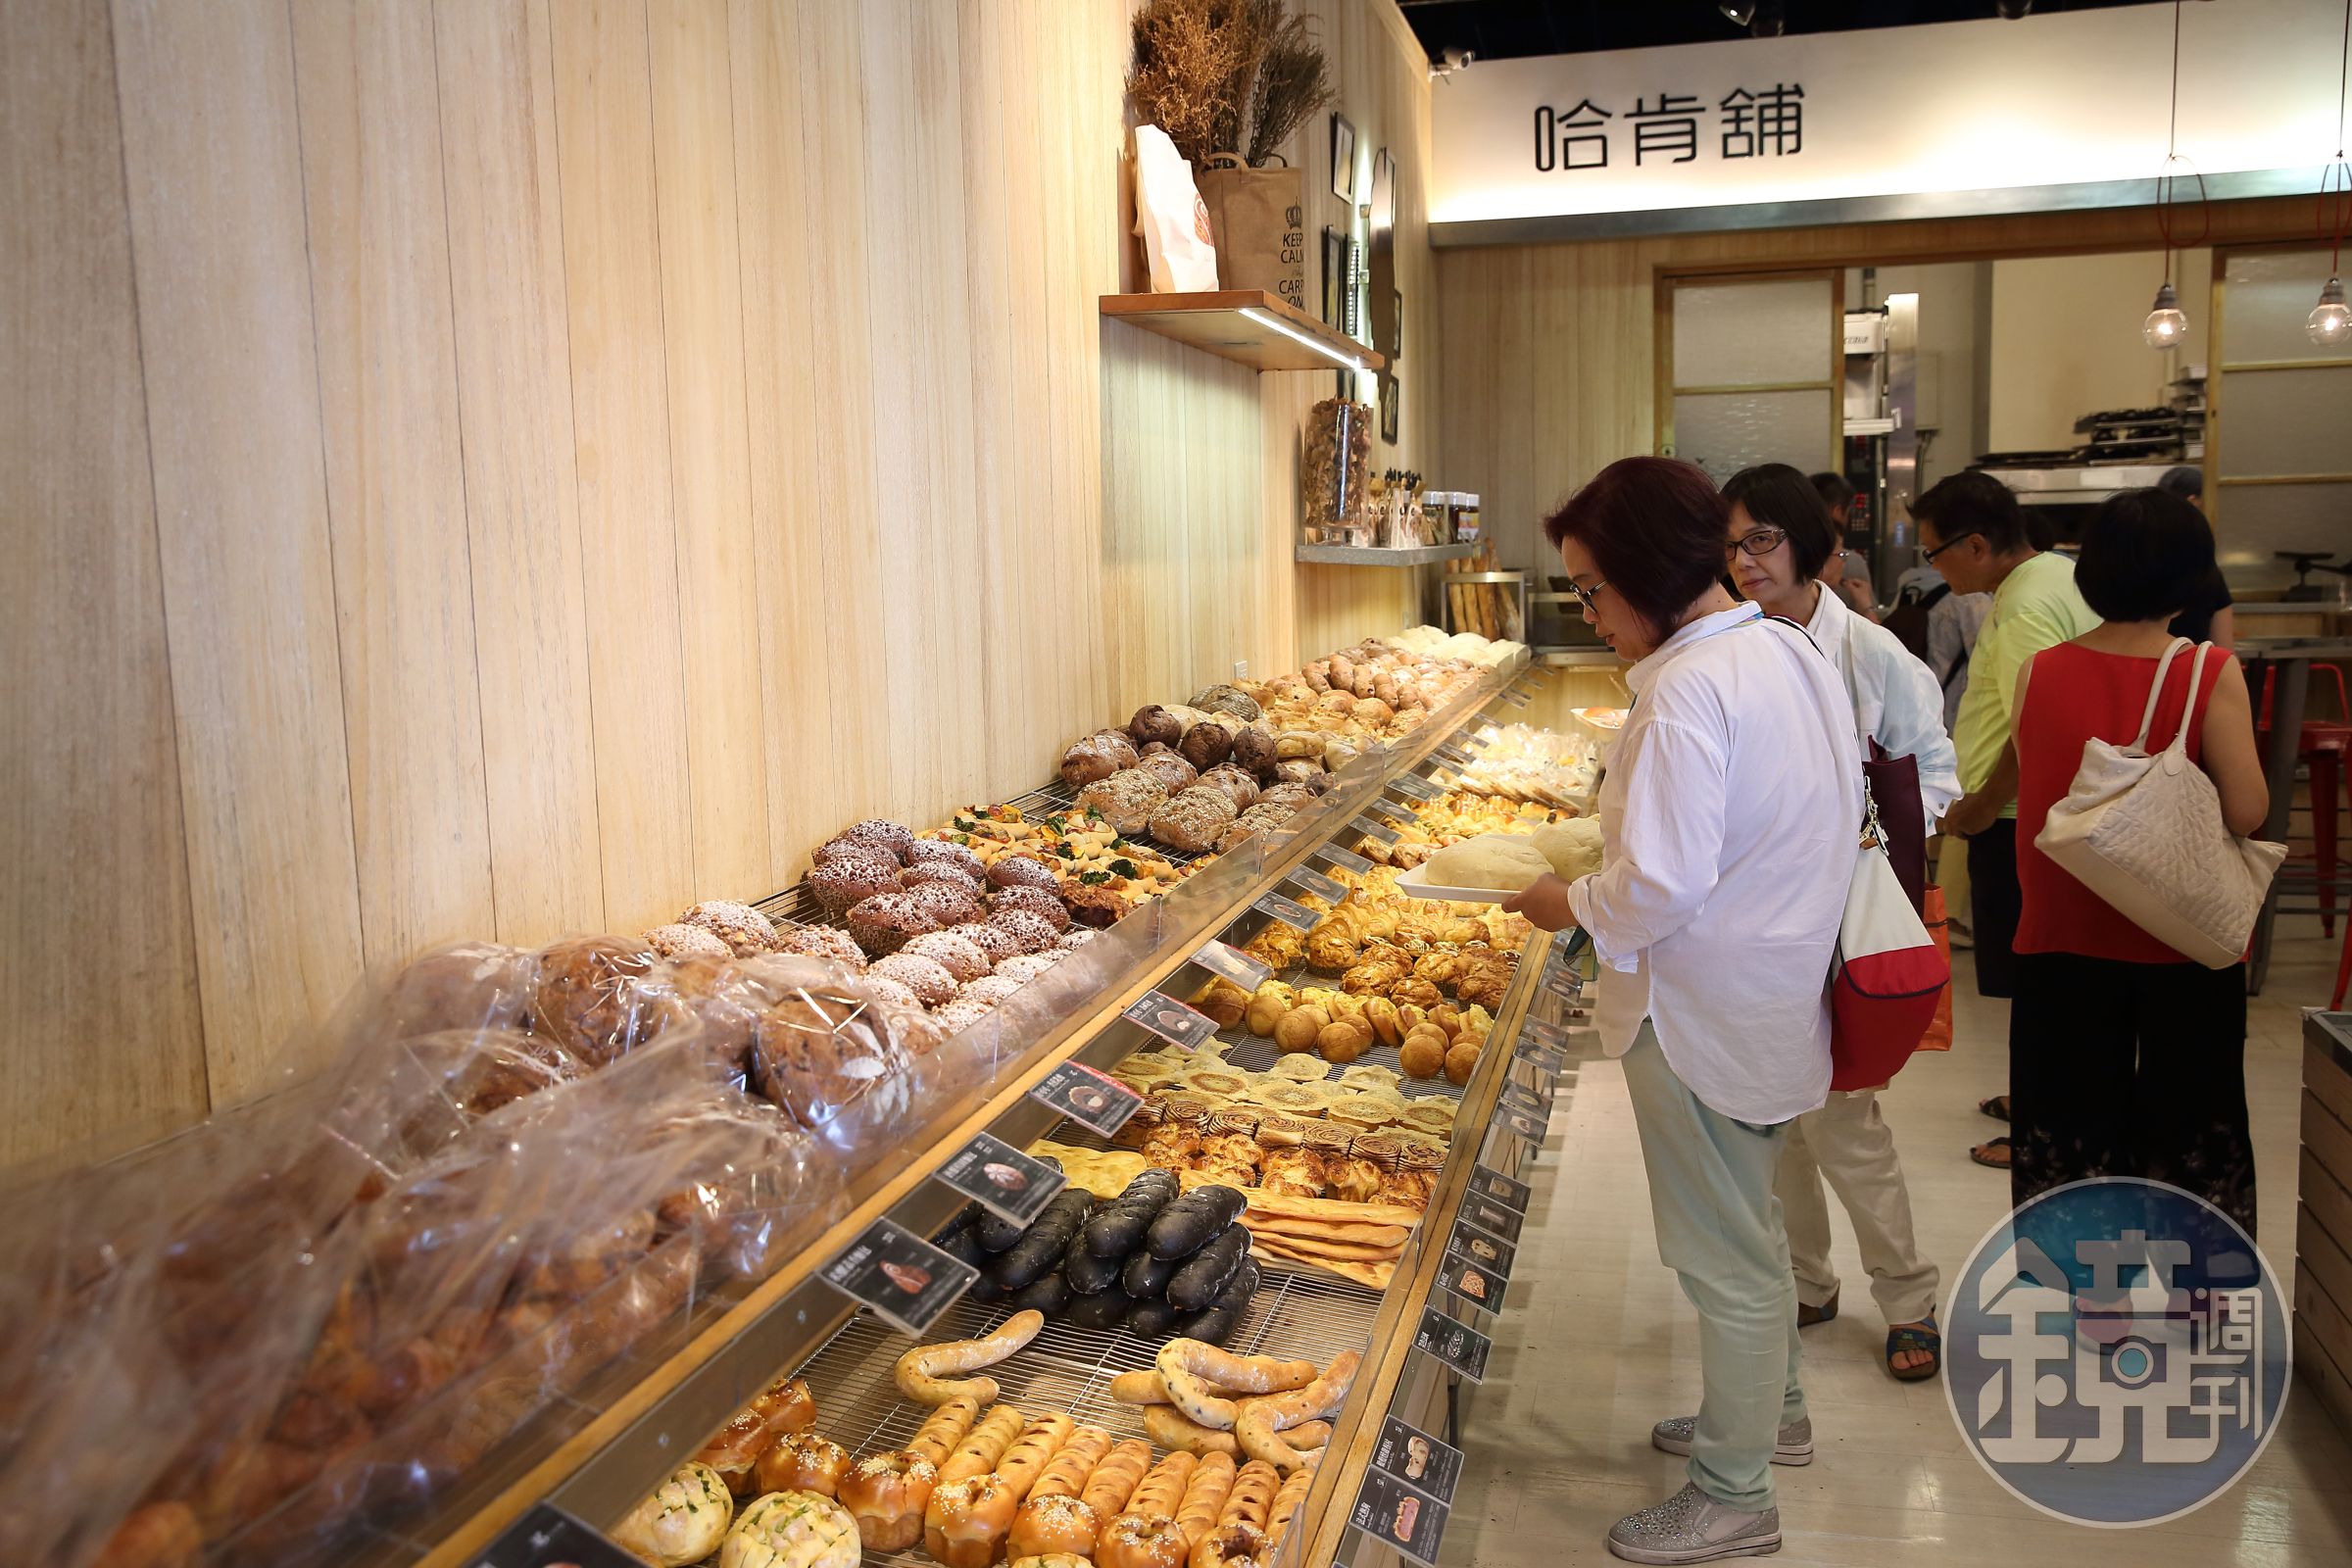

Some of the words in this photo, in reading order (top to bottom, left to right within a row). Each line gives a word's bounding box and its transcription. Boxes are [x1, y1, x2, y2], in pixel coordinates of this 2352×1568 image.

[1535, 83, 1805, 172] 哈肯舖
[1283, 232, 1303, 247] KEEP
